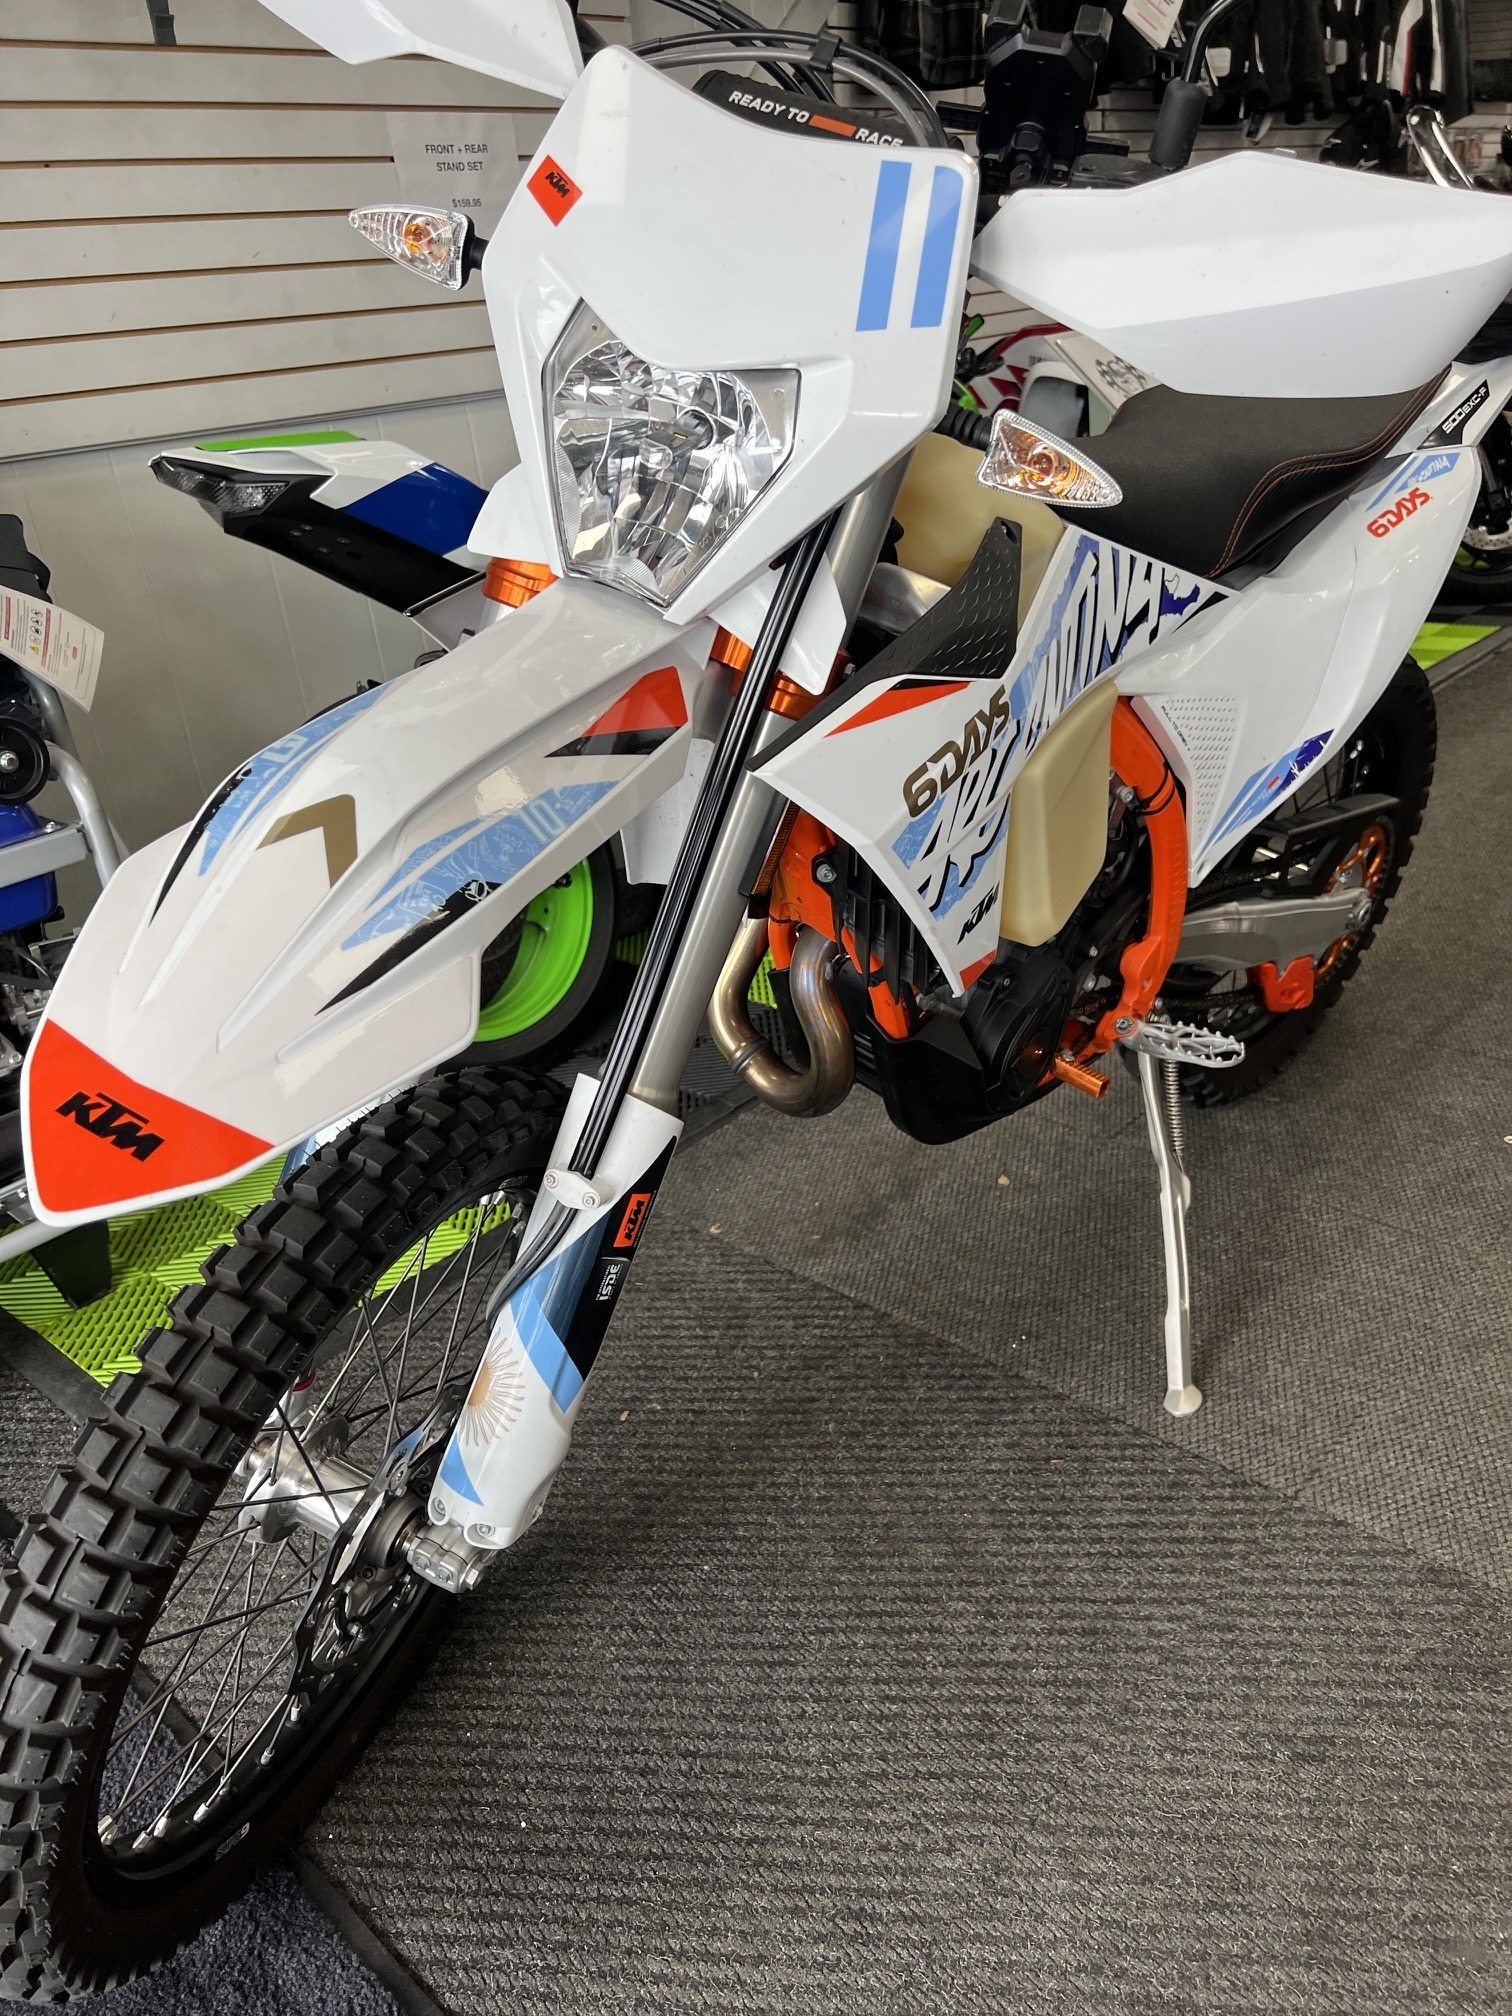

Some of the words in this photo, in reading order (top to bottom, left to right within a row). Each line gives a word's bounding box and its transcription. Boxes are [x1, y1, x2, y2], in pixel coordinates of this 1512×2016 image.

[728, 91, 788, 116] READY
[787, 107, 810, 123] TO
[425, 144, 454, 154] FRONT
[464, 144, 489, 153] REAR
[436, 162, 465, 171] STAND
[467, 162, 483, 171] SET
[545, 171, 571, 198] KTM
[1366, 486, 1430, 538] 6DAYS
[903, 684, 1010, 818] 6DAYS
[957, 880, 1000, 946] KTM
[55, 1091, 166, 1162] KTM
[624, 1199, 645, 1241] KTM
